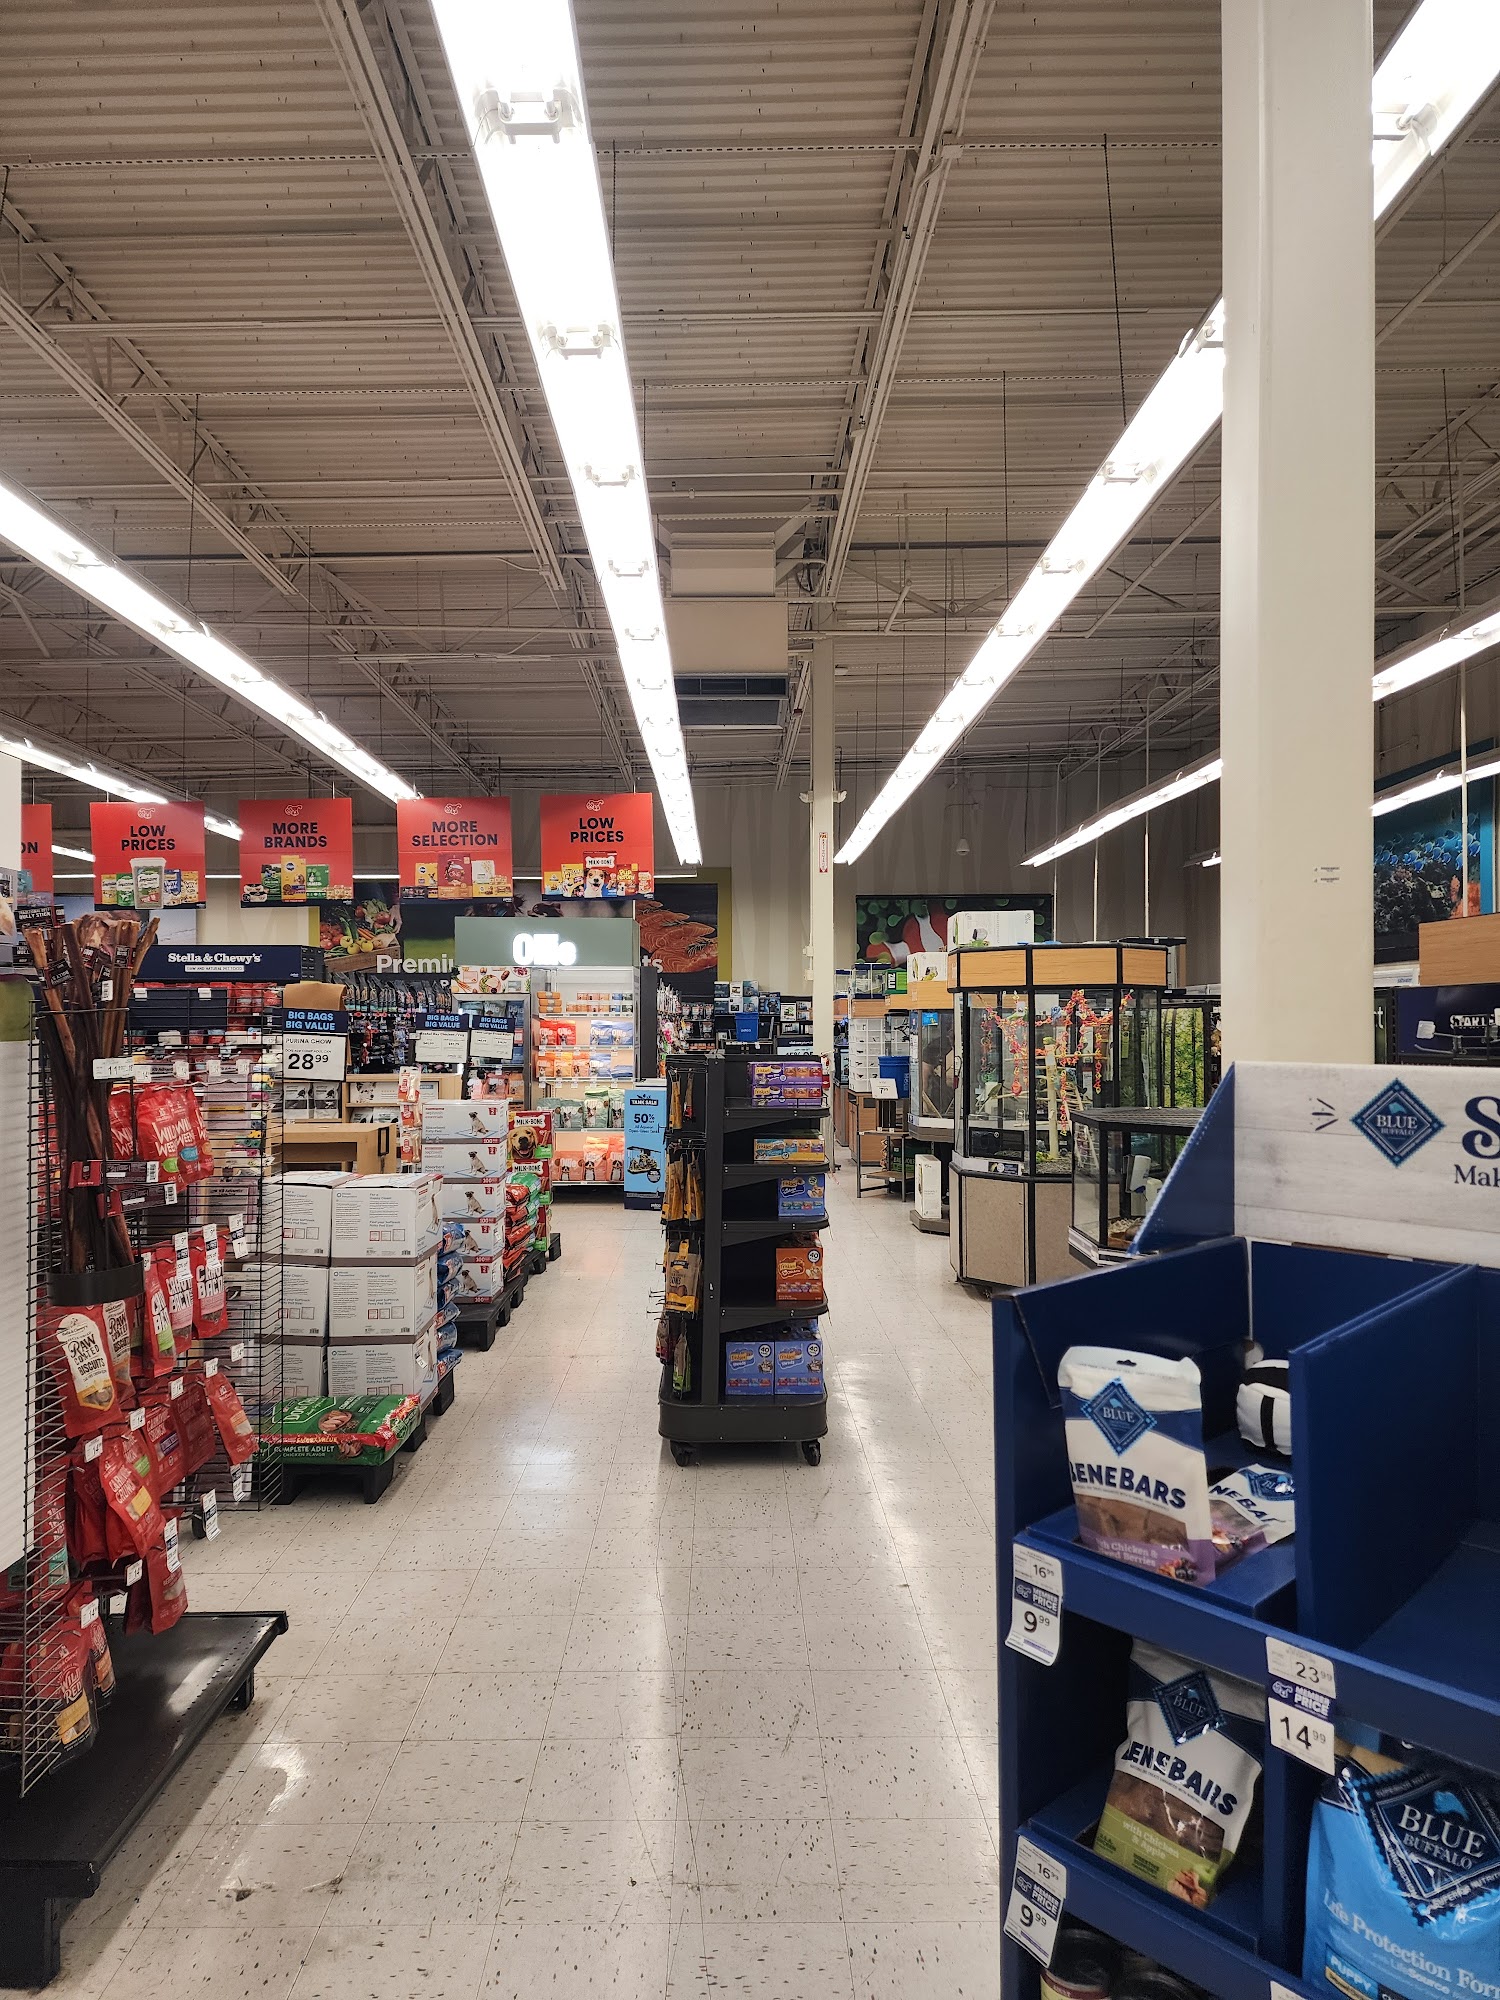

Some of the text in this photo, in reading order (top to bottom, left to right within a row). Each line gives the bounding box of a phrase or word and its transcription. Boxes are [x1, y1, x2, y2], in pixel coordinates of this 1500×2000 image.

[130, 825, 166, 837] LOW
[272, 822, 318, 835] MORE
[432, 821, 478, 833] MORE
[579, 817, 614, 830] LOW
[264, 835, 328, 848] BRANDS
[412, 833, 498, 847] SELECTION
[570, 830, 624, 843] PRICES
[121, 838, 176, 851] PRICES
[168, 953, 263, 965] Stella & Chewy's
[288, 1011, 334, 1021] BIG BAGS
[440, 1014, 459, 1022] BAGS
[285, 1020, 336, 1031] BIG VALUE
[439, 1021, 460, 1029] VALUE
[1376, 1114, 1418, 1129] BLUE
[1380, 1127, 1415, 1136] BUFFALO
[67, 1333, 96, 1358] RAW
[77, 1357, 106, 1376] BISCUITS
[1103, 1405, 1135, 1424] BLUE
[311, 1444, 335, 1453] ADULT
[1111, 1541, 1148, 1557] Chicken
[1124, 1552, 1157, 1567] Berries
[1032, 1586, 1058, 1603] MEMBER
[1032, 1595, 1058, 1613] PRICE
[1295, 1685, 1330, 1707] MEMBER
[1173, 1695, 1206, 1718] BLUE
[1294, 1693, 1329, 1717] PRICE
[1398, 1804, 1487, 1858] BLUE
[1143, 1832, 1180, 1859] Chicken
[1402, 1832, 1473, 1870] BUFFALO
[1033, 1883, 1059, 1907] MEMBER
[1031, 1892, 1058, 1915] PRICE
[1324, 1887, 1350, 1926] Life
[1352, 1911, 1453, 1983] Protection
[1330, 1955, 1372, 1991] PUPPY
